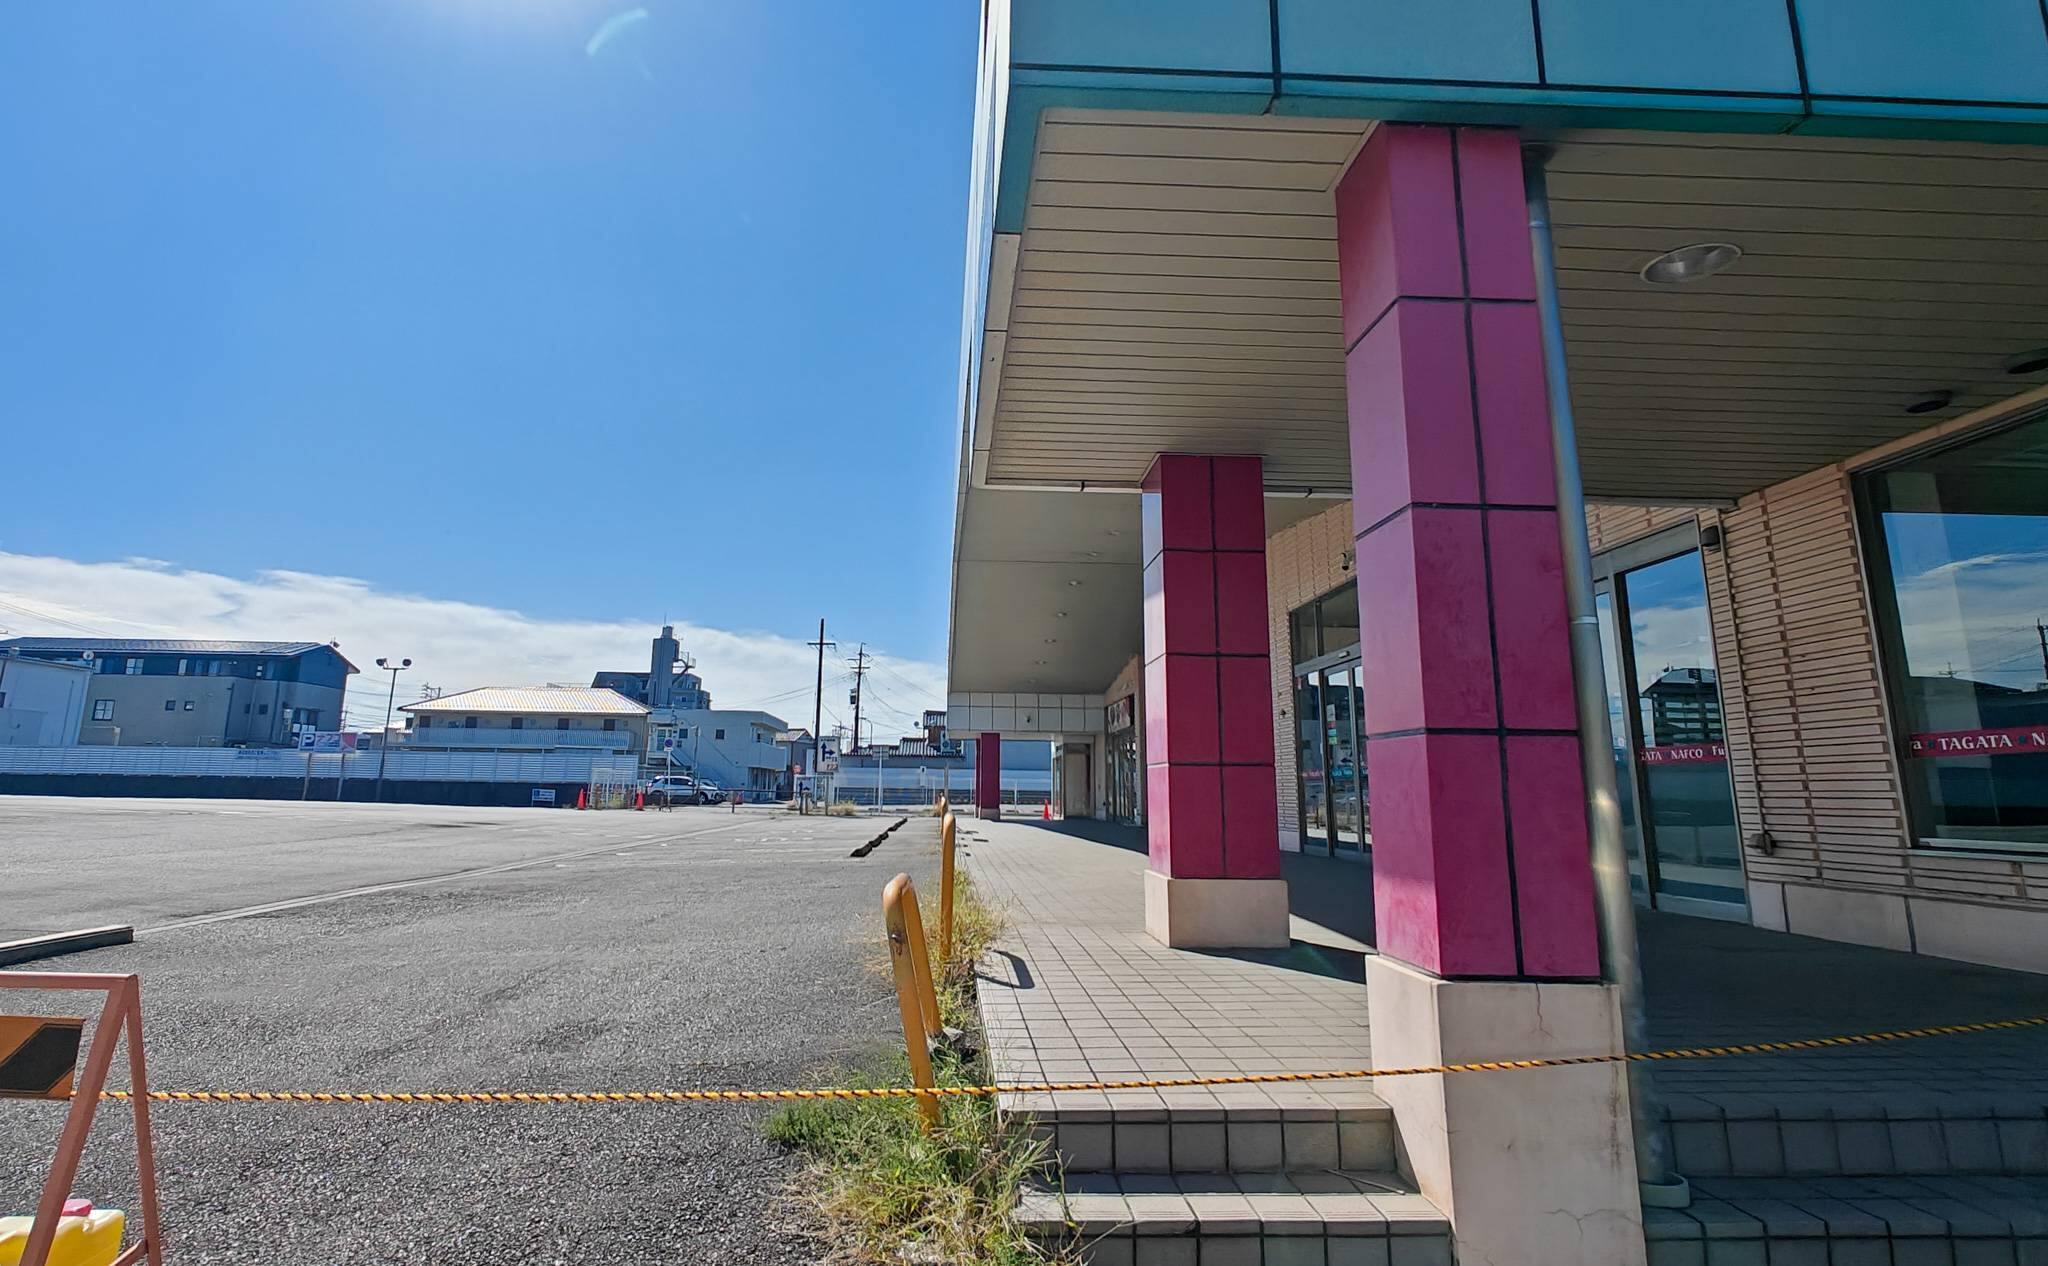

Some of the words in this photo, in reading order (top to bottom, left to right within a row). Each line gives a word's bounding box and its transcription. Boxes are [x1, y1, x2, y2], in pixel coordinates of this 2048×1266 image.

[302, 734, 315, 746] P
[1938, 735, 2013, 751] TAGATA
[2031, 732, 2048, 747] N
[1671, 748, 1703, 760] NAFCO
[1711, 745, 1728, 758] Fu
